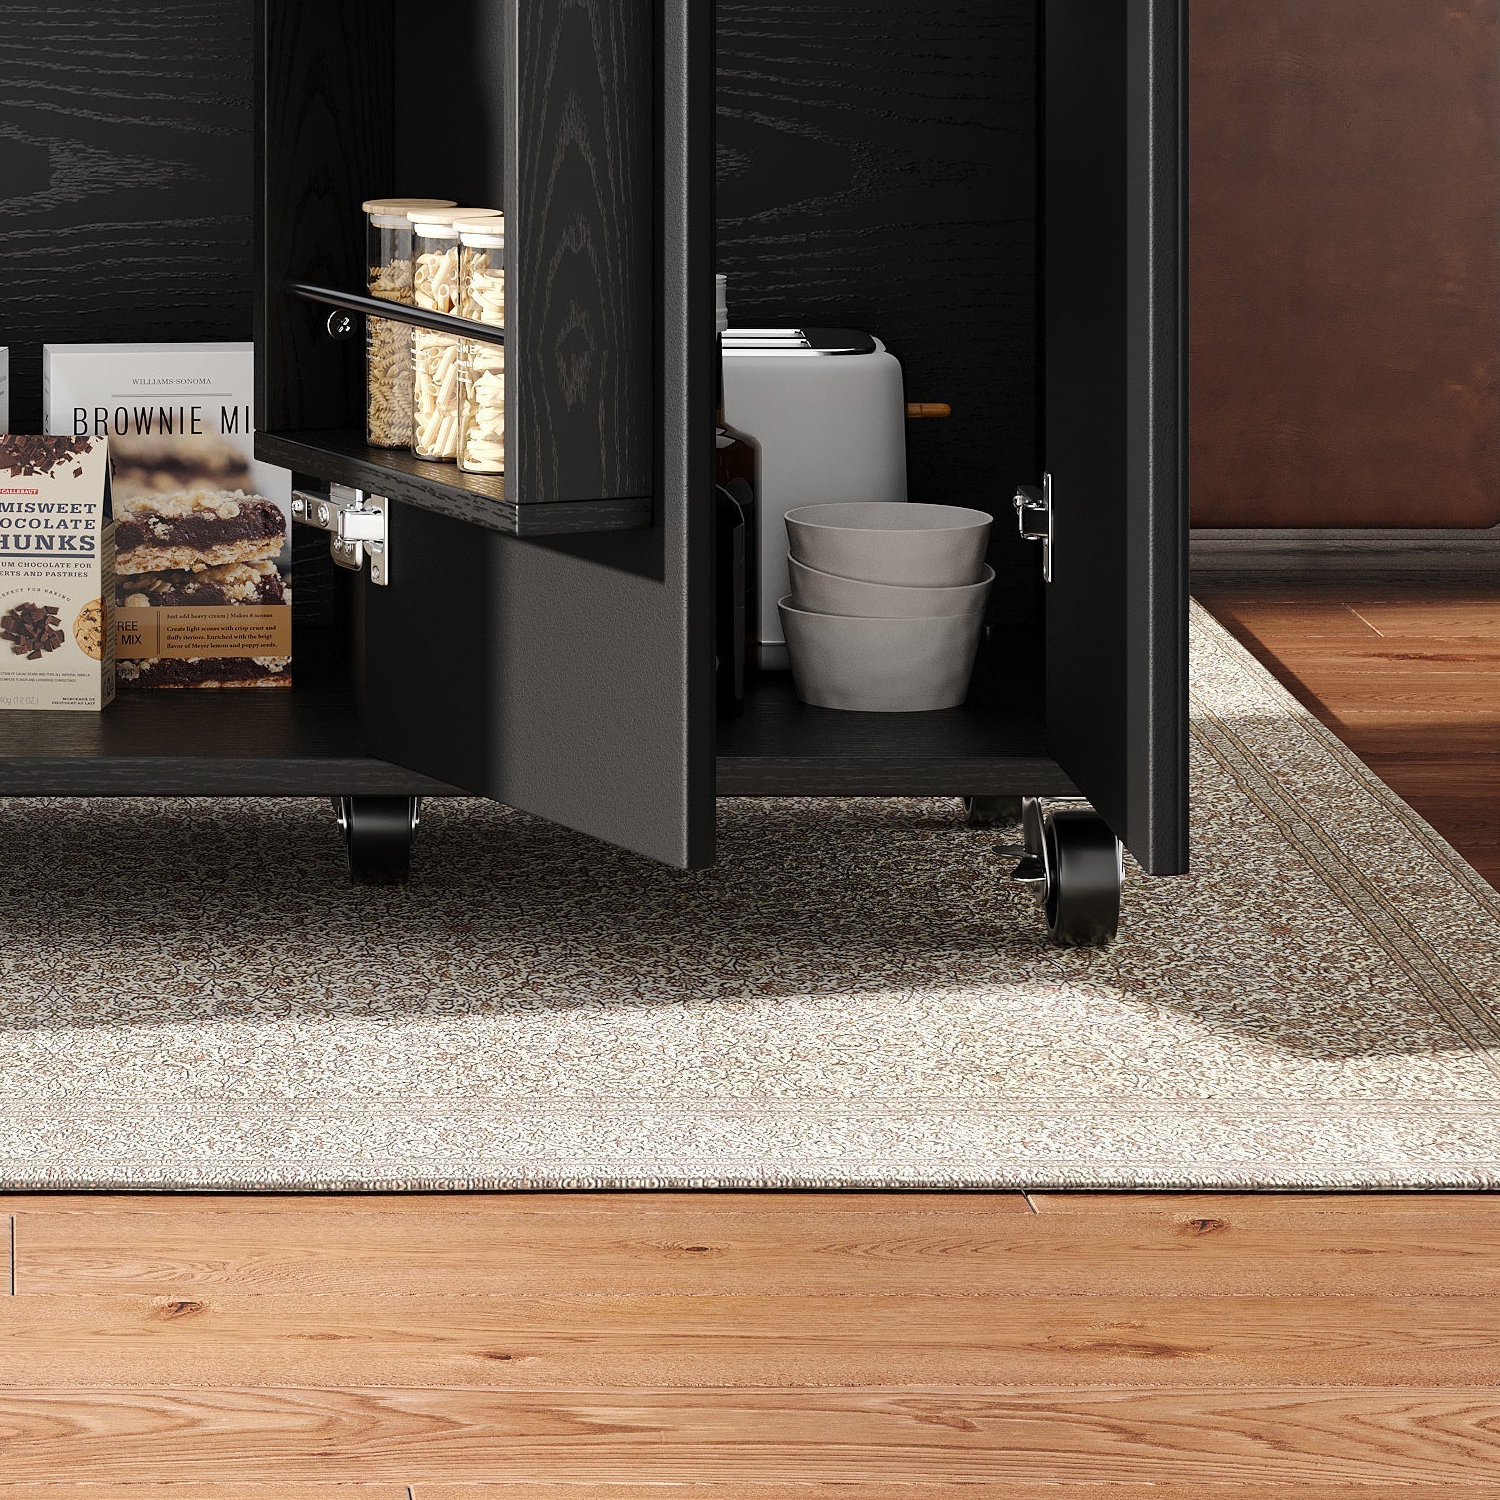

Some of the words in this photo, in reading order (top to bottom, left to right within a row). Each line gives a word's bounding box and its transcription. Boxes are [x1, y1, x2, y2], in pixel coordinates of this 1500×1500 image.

[73, 406, 203, 436] BROWNIE
[221, 405, 250, 434] MI
[44, 589, 71, 602] BAKING
[115, 621, 138, 632] REE
[186, 625, 200, 633] light
[121, 635, 142, 645] MIX
[13, 696, 25, 705] (12
